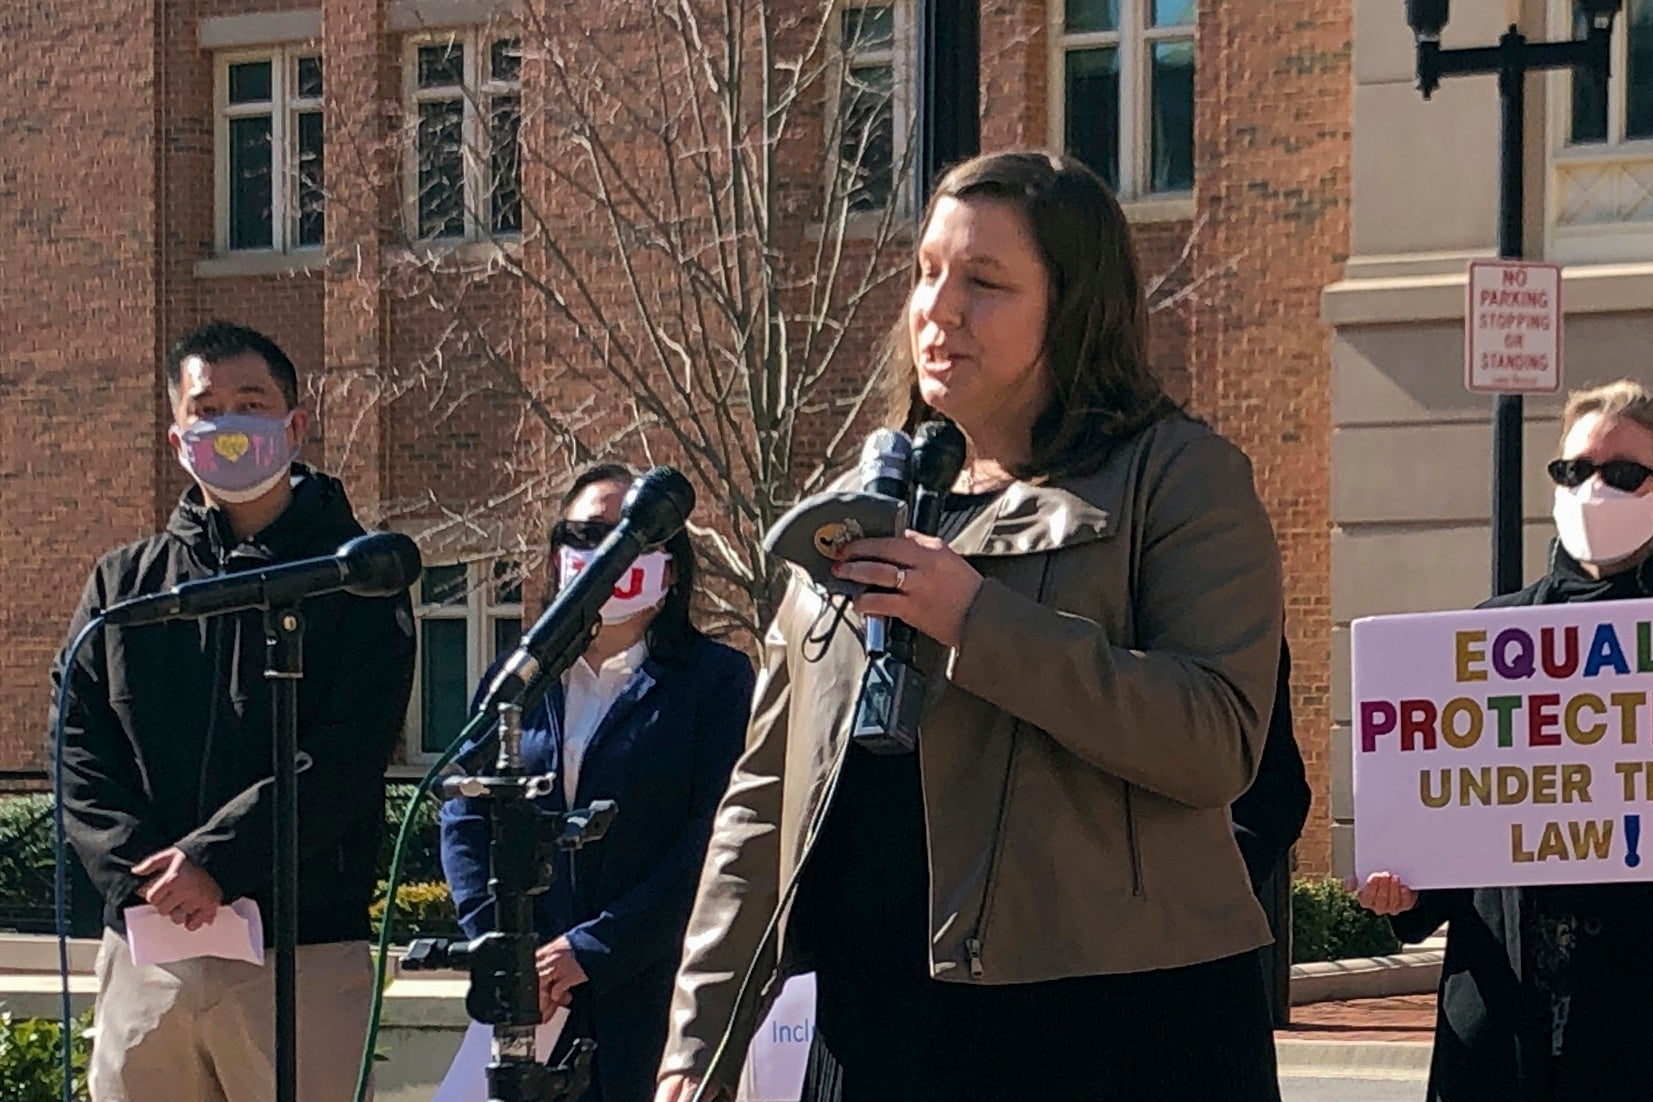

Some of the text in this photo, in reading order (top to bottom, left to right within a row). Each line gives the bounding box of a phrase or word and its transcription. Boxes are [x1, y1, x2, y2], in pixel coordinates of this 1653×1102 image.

[1502, 269, 1528, 287] NO
[1480, 289, 1548, 308] PARKING
[1479, 312, 1550, 331] STOPPING
[1504, 333, 1523, 349] OR
[1480, 352, 1549, 371] STANDING
[1419, 763, 1593, 809] UNDER
[1510, 814, 1641, 869] LAW!
[772, 1018, 816, 1044] Incl
